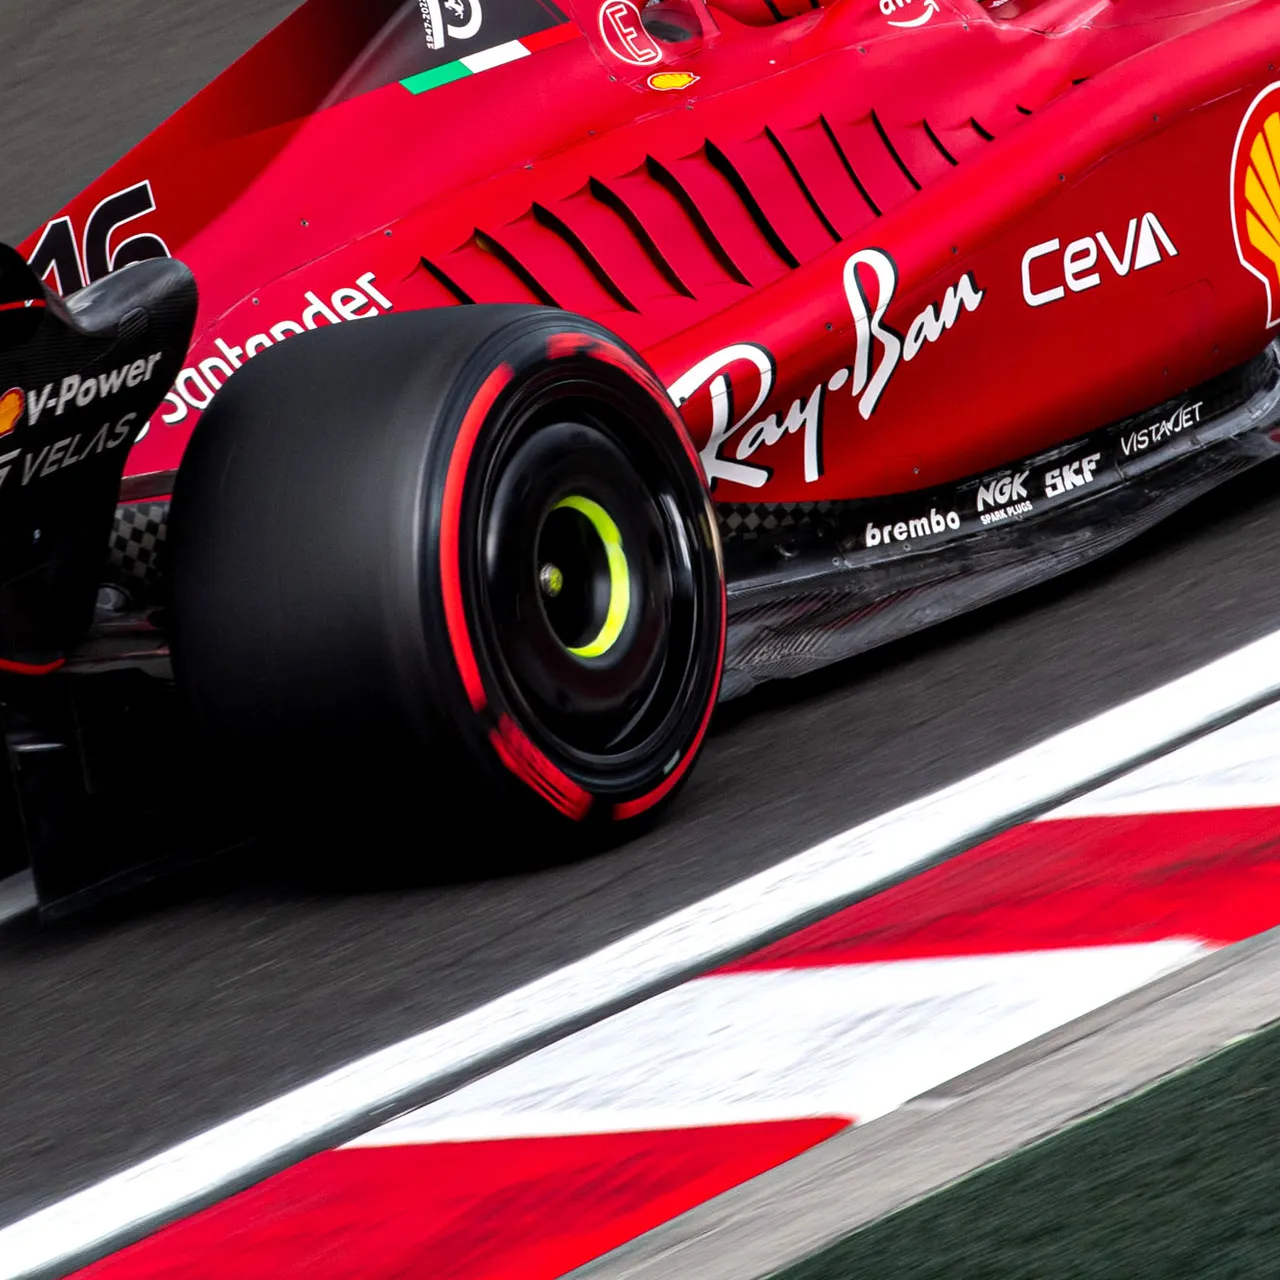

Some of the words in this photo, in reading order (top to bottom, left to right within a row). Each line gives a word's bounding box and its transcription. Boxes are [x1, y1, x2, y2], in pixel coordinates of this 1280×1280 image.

[26, 179, 172, 297] 16
[26, 351, 163, 426] V-Power
[20, 412, 137, 487] VELAS
[1120, 401, 1204, 456] VISTAJET
[976, 469, 1031, 511] NGK
[1044, 452, 1101, 498] SKF
[864, 507, 961, 548] brembo
[980, 509, 1007, 525] SPARK
[1006, 500, 1033, 519] PLUGS
